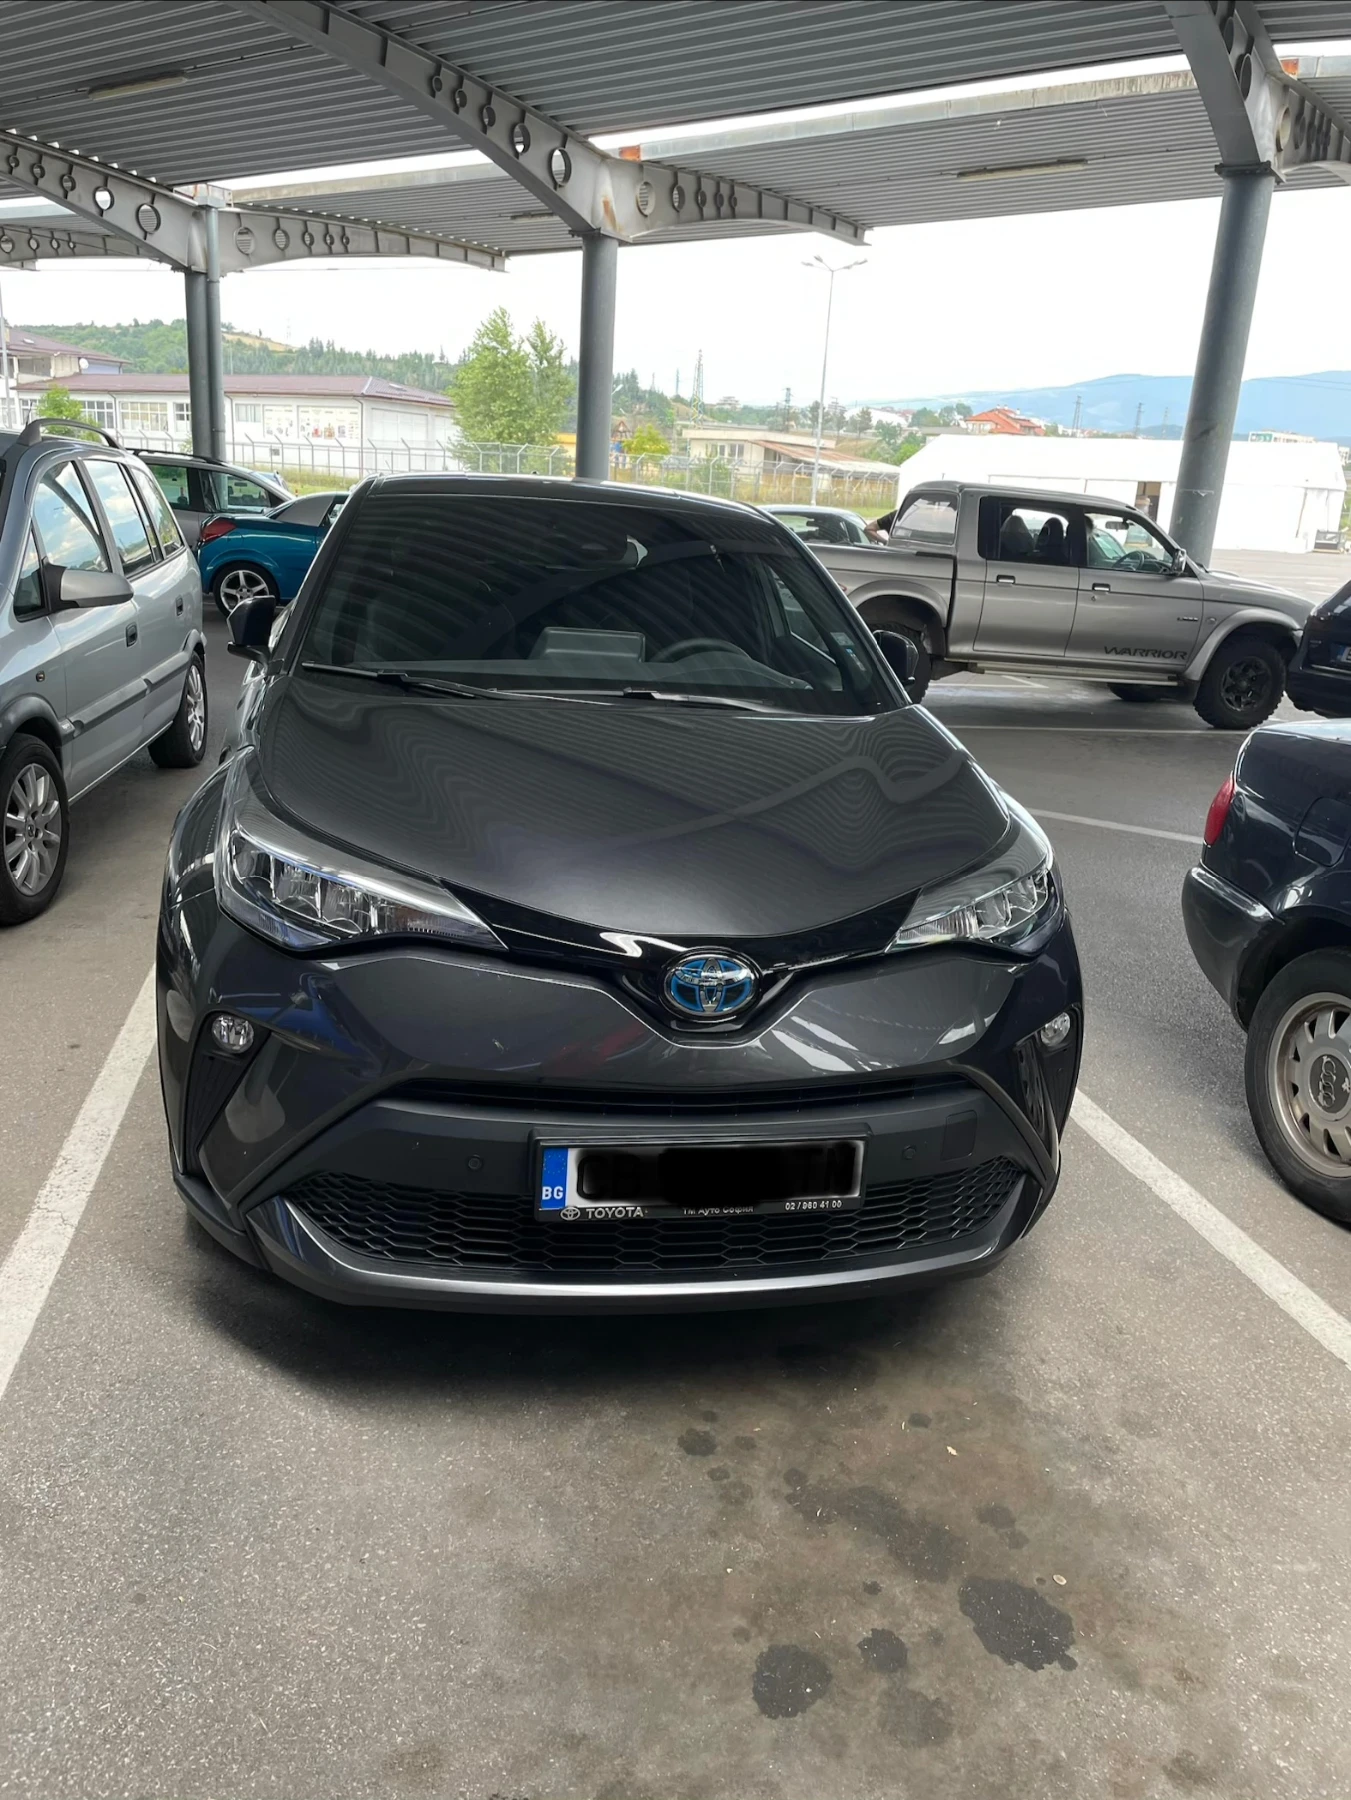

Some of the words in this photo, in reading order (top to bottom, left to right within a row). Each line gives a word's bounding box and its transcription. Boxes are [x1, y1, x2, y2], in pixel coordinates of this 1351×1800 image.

[1104, 646, 1188, 660] WARRIOR
[542, 1186, 564, 1200] BG
[785, 1202, 796, 1210] 02
[831, 1199, 842, 1208] 00
[586, 1206, 644, 1219] TOYOTA
